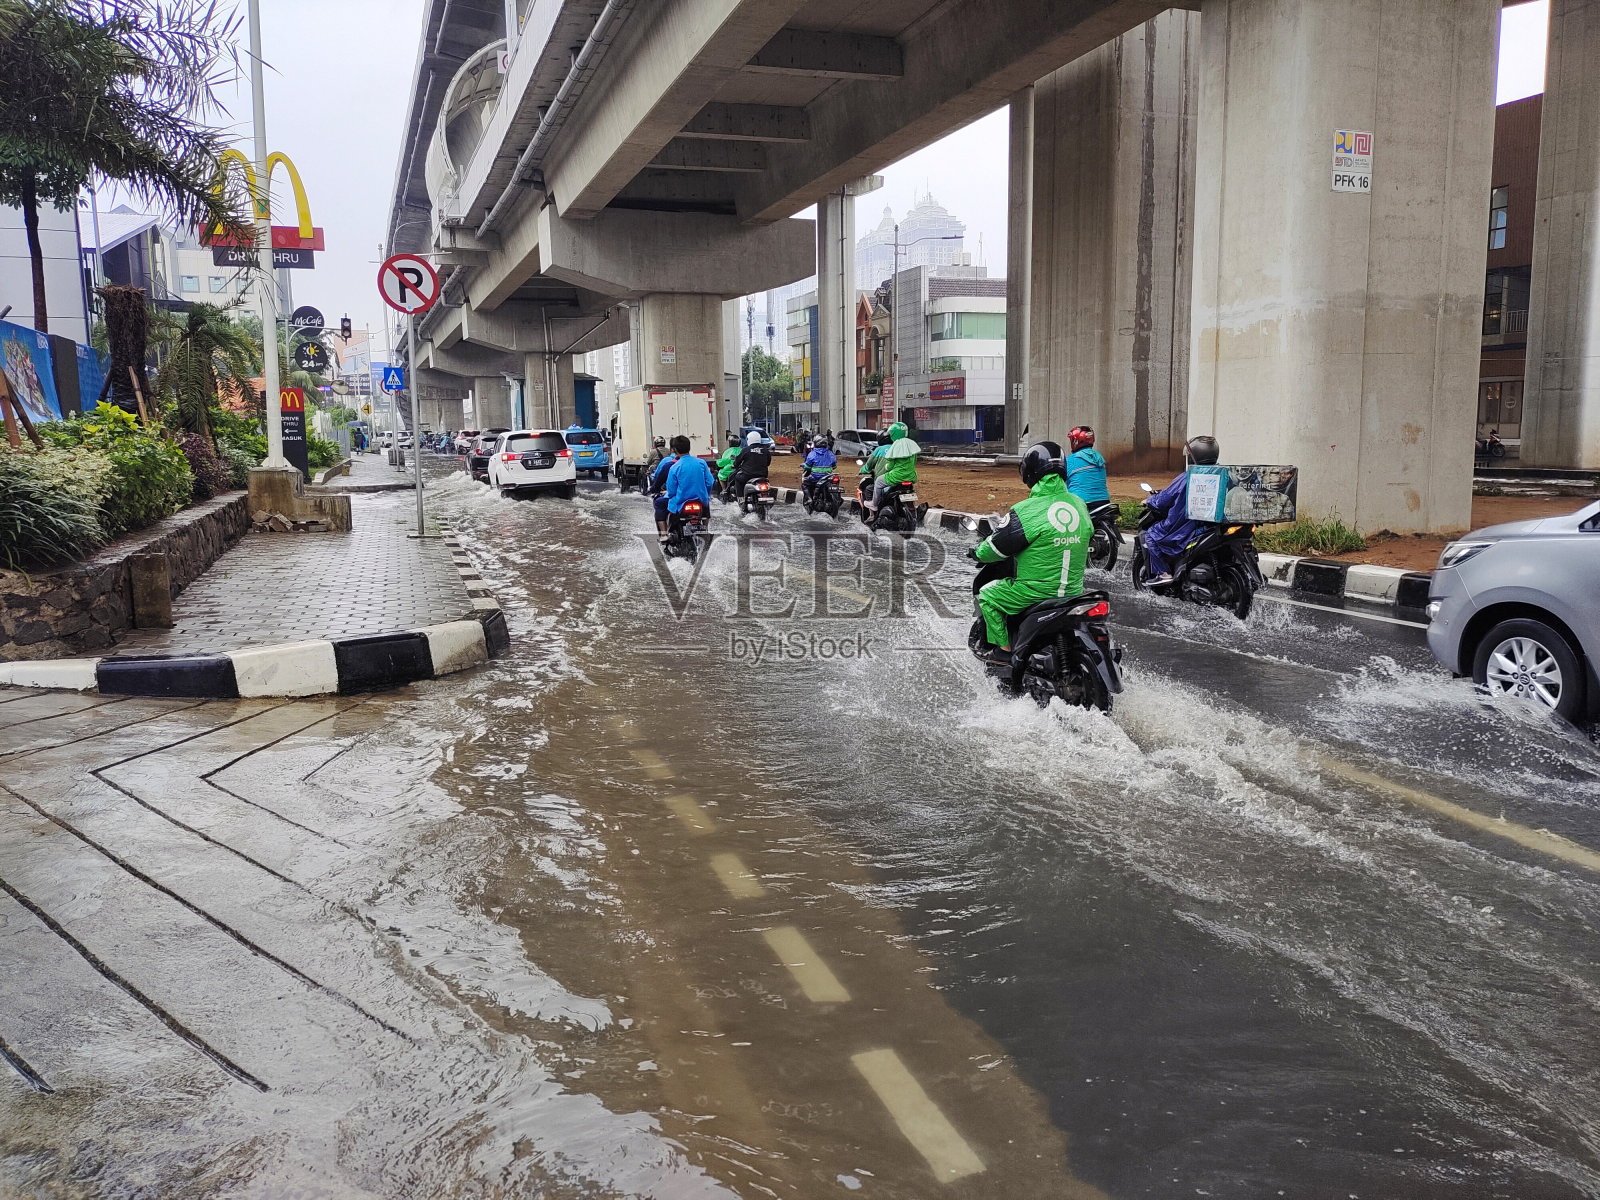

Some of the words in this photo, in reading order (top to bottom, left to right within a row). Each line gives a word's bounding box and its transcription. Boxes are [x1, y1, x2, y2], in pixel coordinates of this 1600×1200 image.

[1334, 174, 1356, 188] PFK
[1358, 175, 1369, 189] 16
[272, 252, 299, 263] HRU
[398, 267, 424, 303] P
[302, 360, 315, 368] 24
[1053, 535, 1081, 547] gojek
